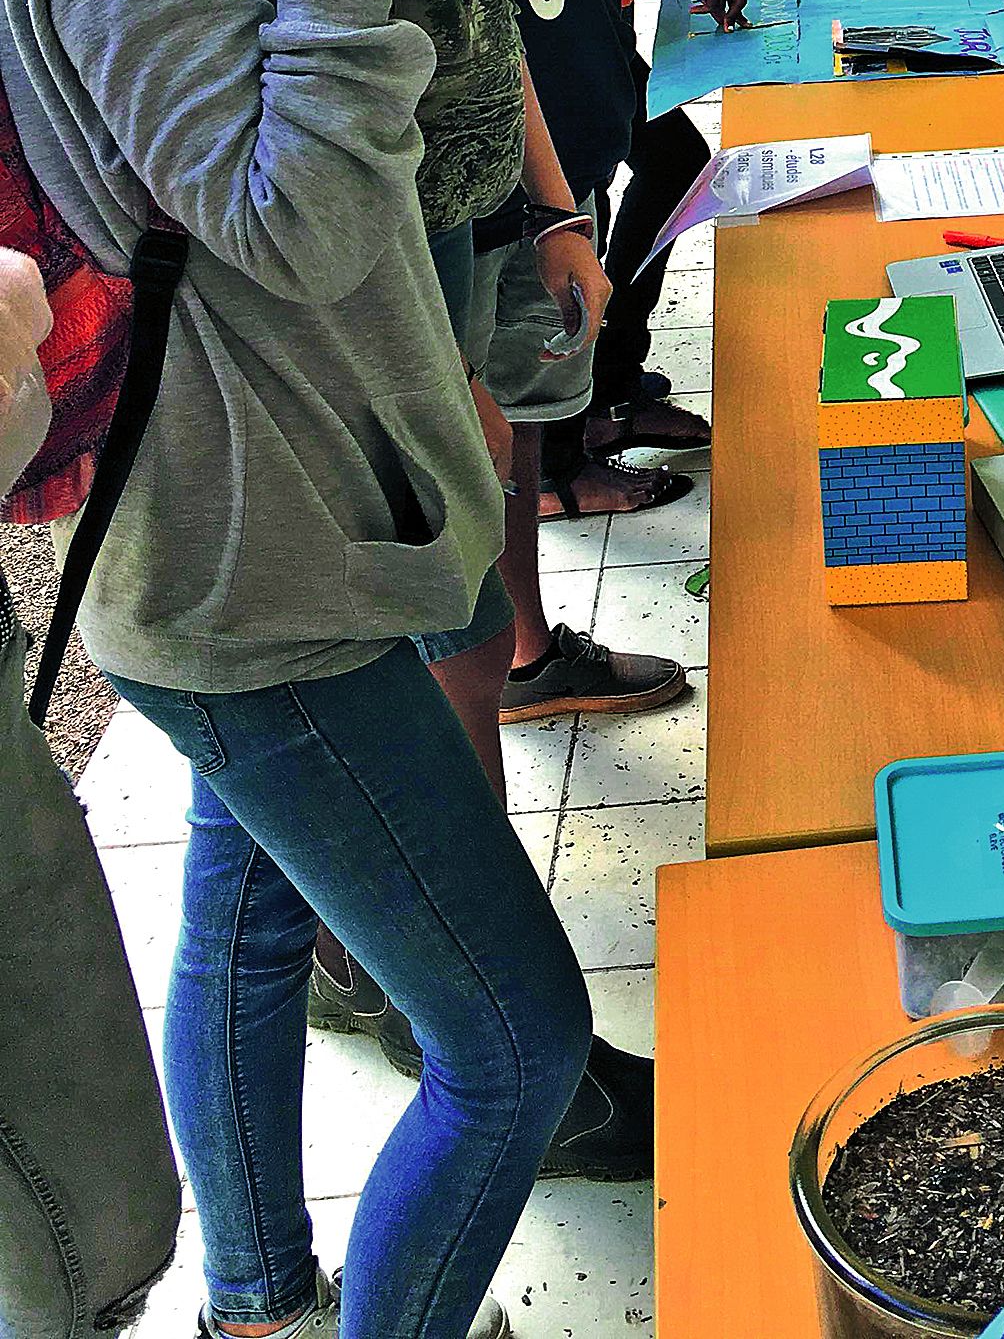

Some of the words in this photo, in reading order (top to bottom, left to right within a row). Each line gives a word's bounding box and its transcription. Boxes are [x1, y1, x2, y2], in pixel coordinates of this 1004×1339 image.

[758, 149, 777, 191] sismiques
[785, 154, 803, 184] études
[810, 147, 825, 165] L28
